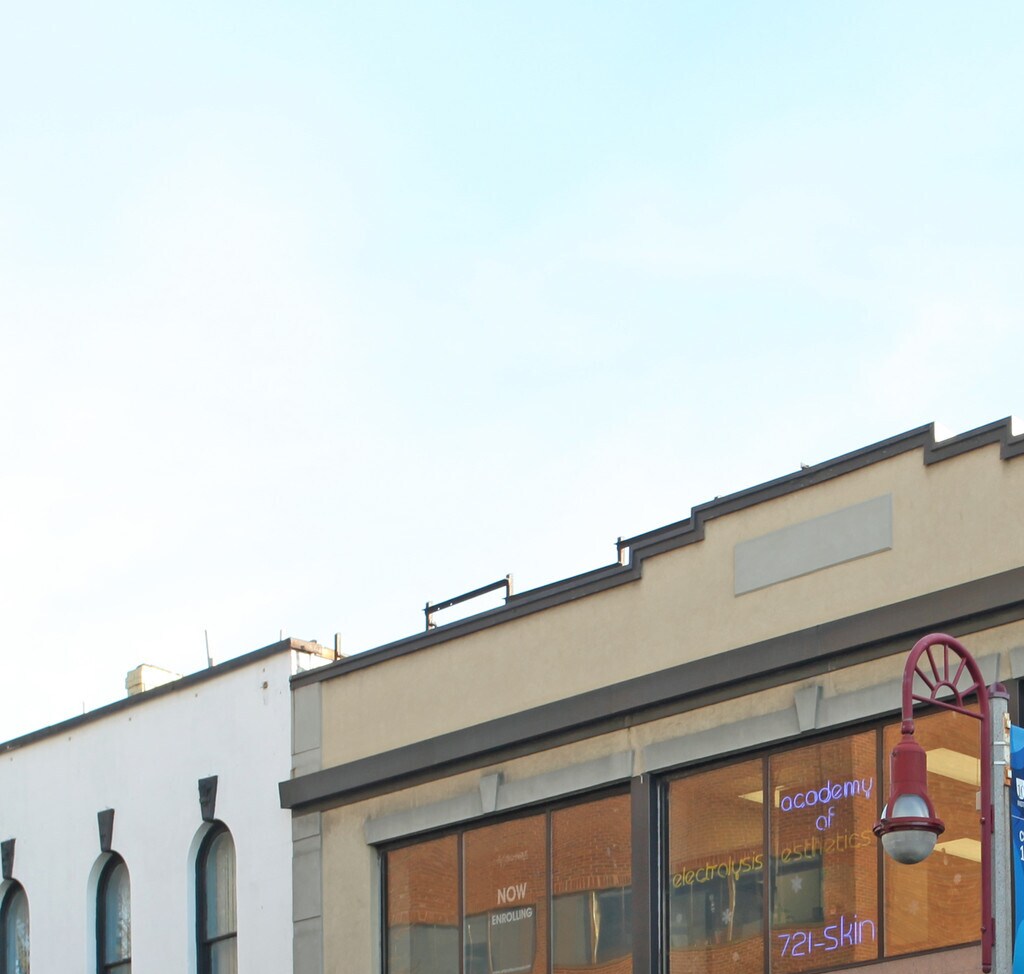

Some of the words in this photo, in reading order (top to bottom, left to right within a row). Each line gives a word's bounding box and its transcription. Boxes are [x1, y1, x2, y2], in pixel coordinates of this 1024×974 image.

[780, 777, 873, 812] academy
[815, 806, 835, 830] of
[781, 829, 872, 864] esthetics
[672, 852, 764, 888] electrolysis
[497, 882, 527, 905] NOW
[491, 907, 533, 926] ENROLLING
